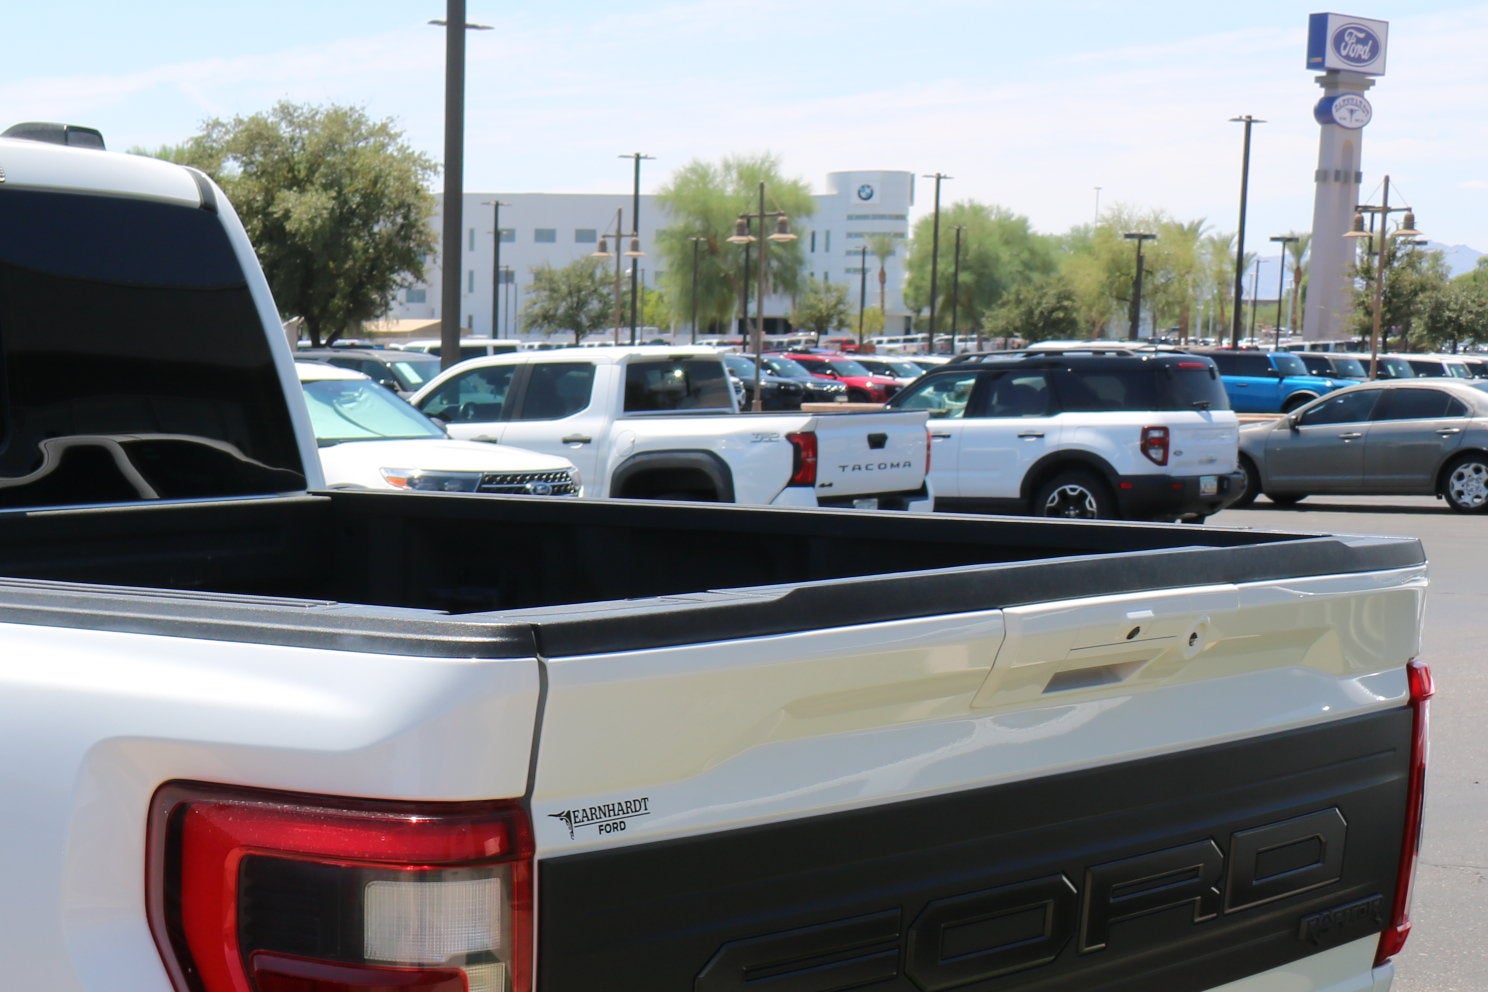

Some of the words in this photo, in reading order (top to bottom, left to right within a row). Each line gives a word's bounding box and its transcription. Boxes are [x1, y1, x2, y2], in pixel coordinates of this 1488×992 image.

[1340, 29, 1372, 60] Ford
[838, 461, 912, 473] TACOMA
[572, 797, 649, 824] EARNHARDT
[598, 820, 627, 835] FORD
